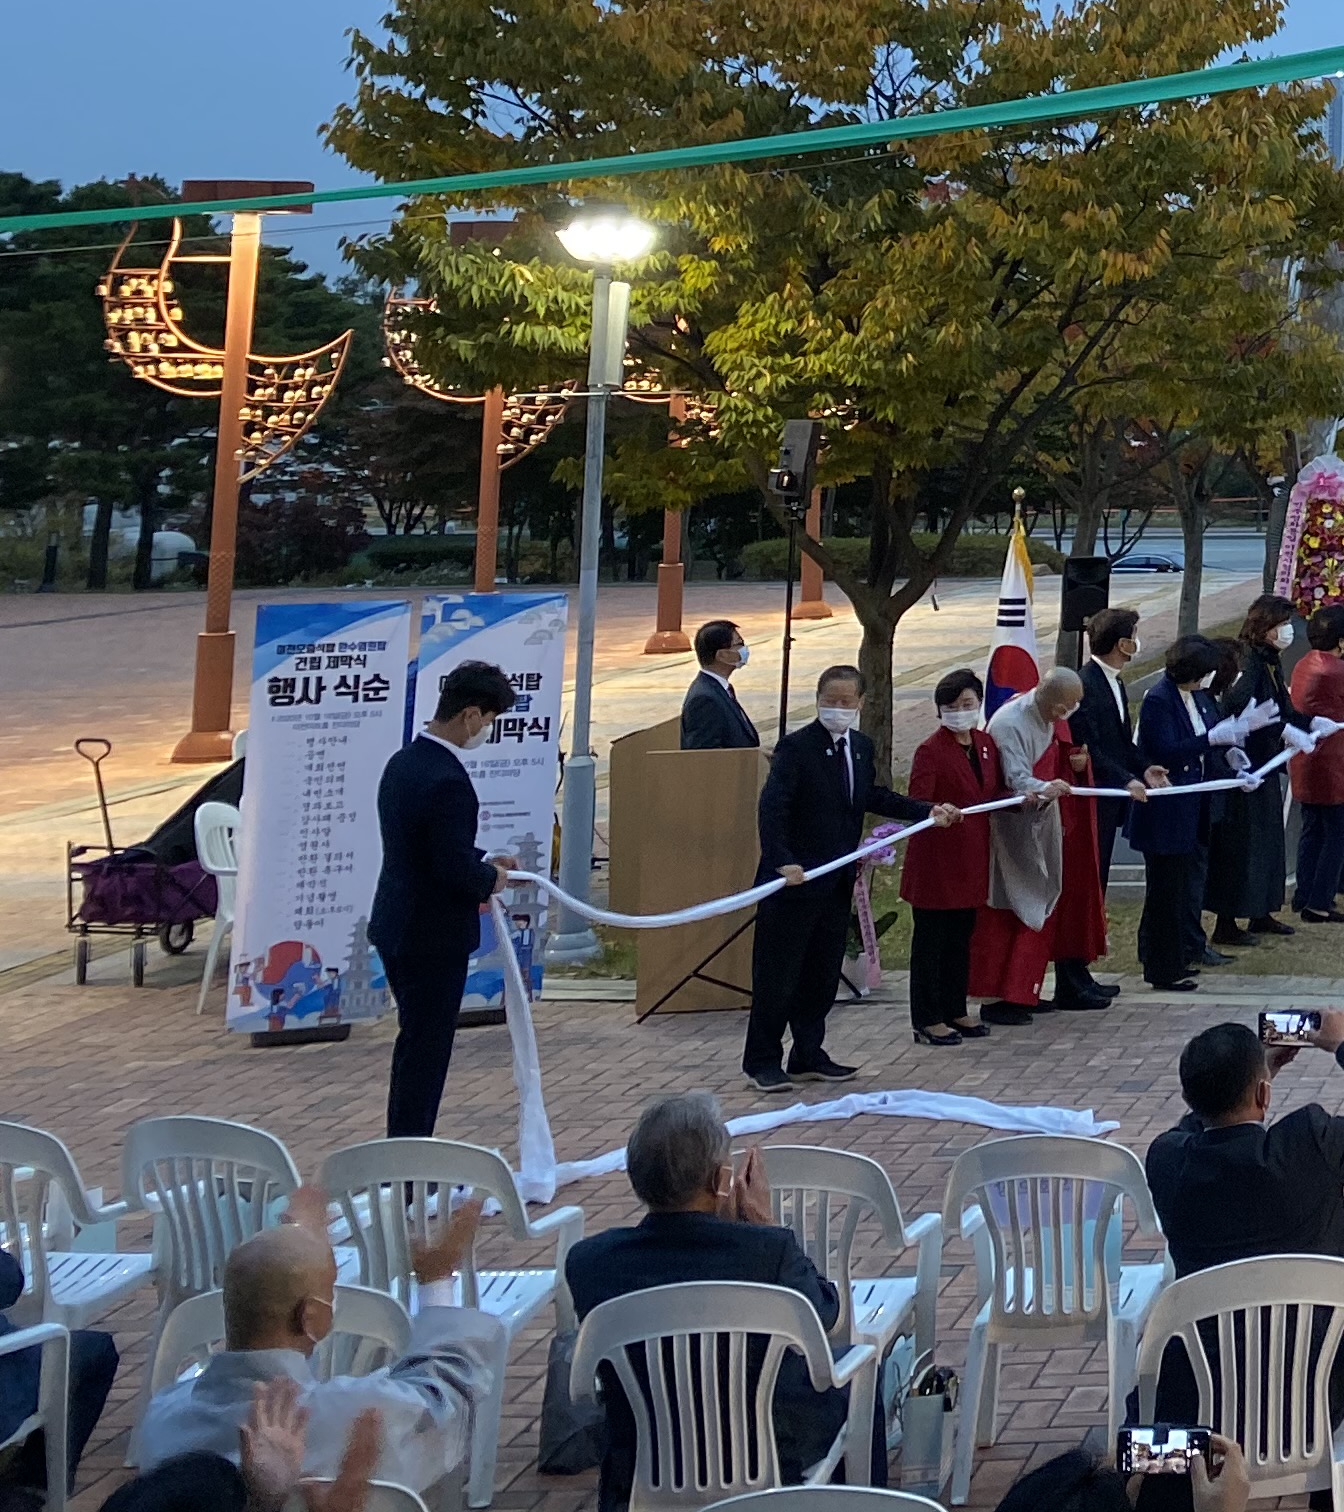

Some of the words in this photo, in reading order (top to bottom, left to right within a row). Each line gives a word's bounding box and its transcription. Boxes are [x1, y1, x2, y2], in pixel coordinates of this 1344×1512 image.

[294, 656, 322, 671] 건립
[325, 654, 367, 669] 제막식
[267, 676, 327, 706] 행사
[333, 673, 390, 703] 식순
[531, 757, 545, 766] 5시
